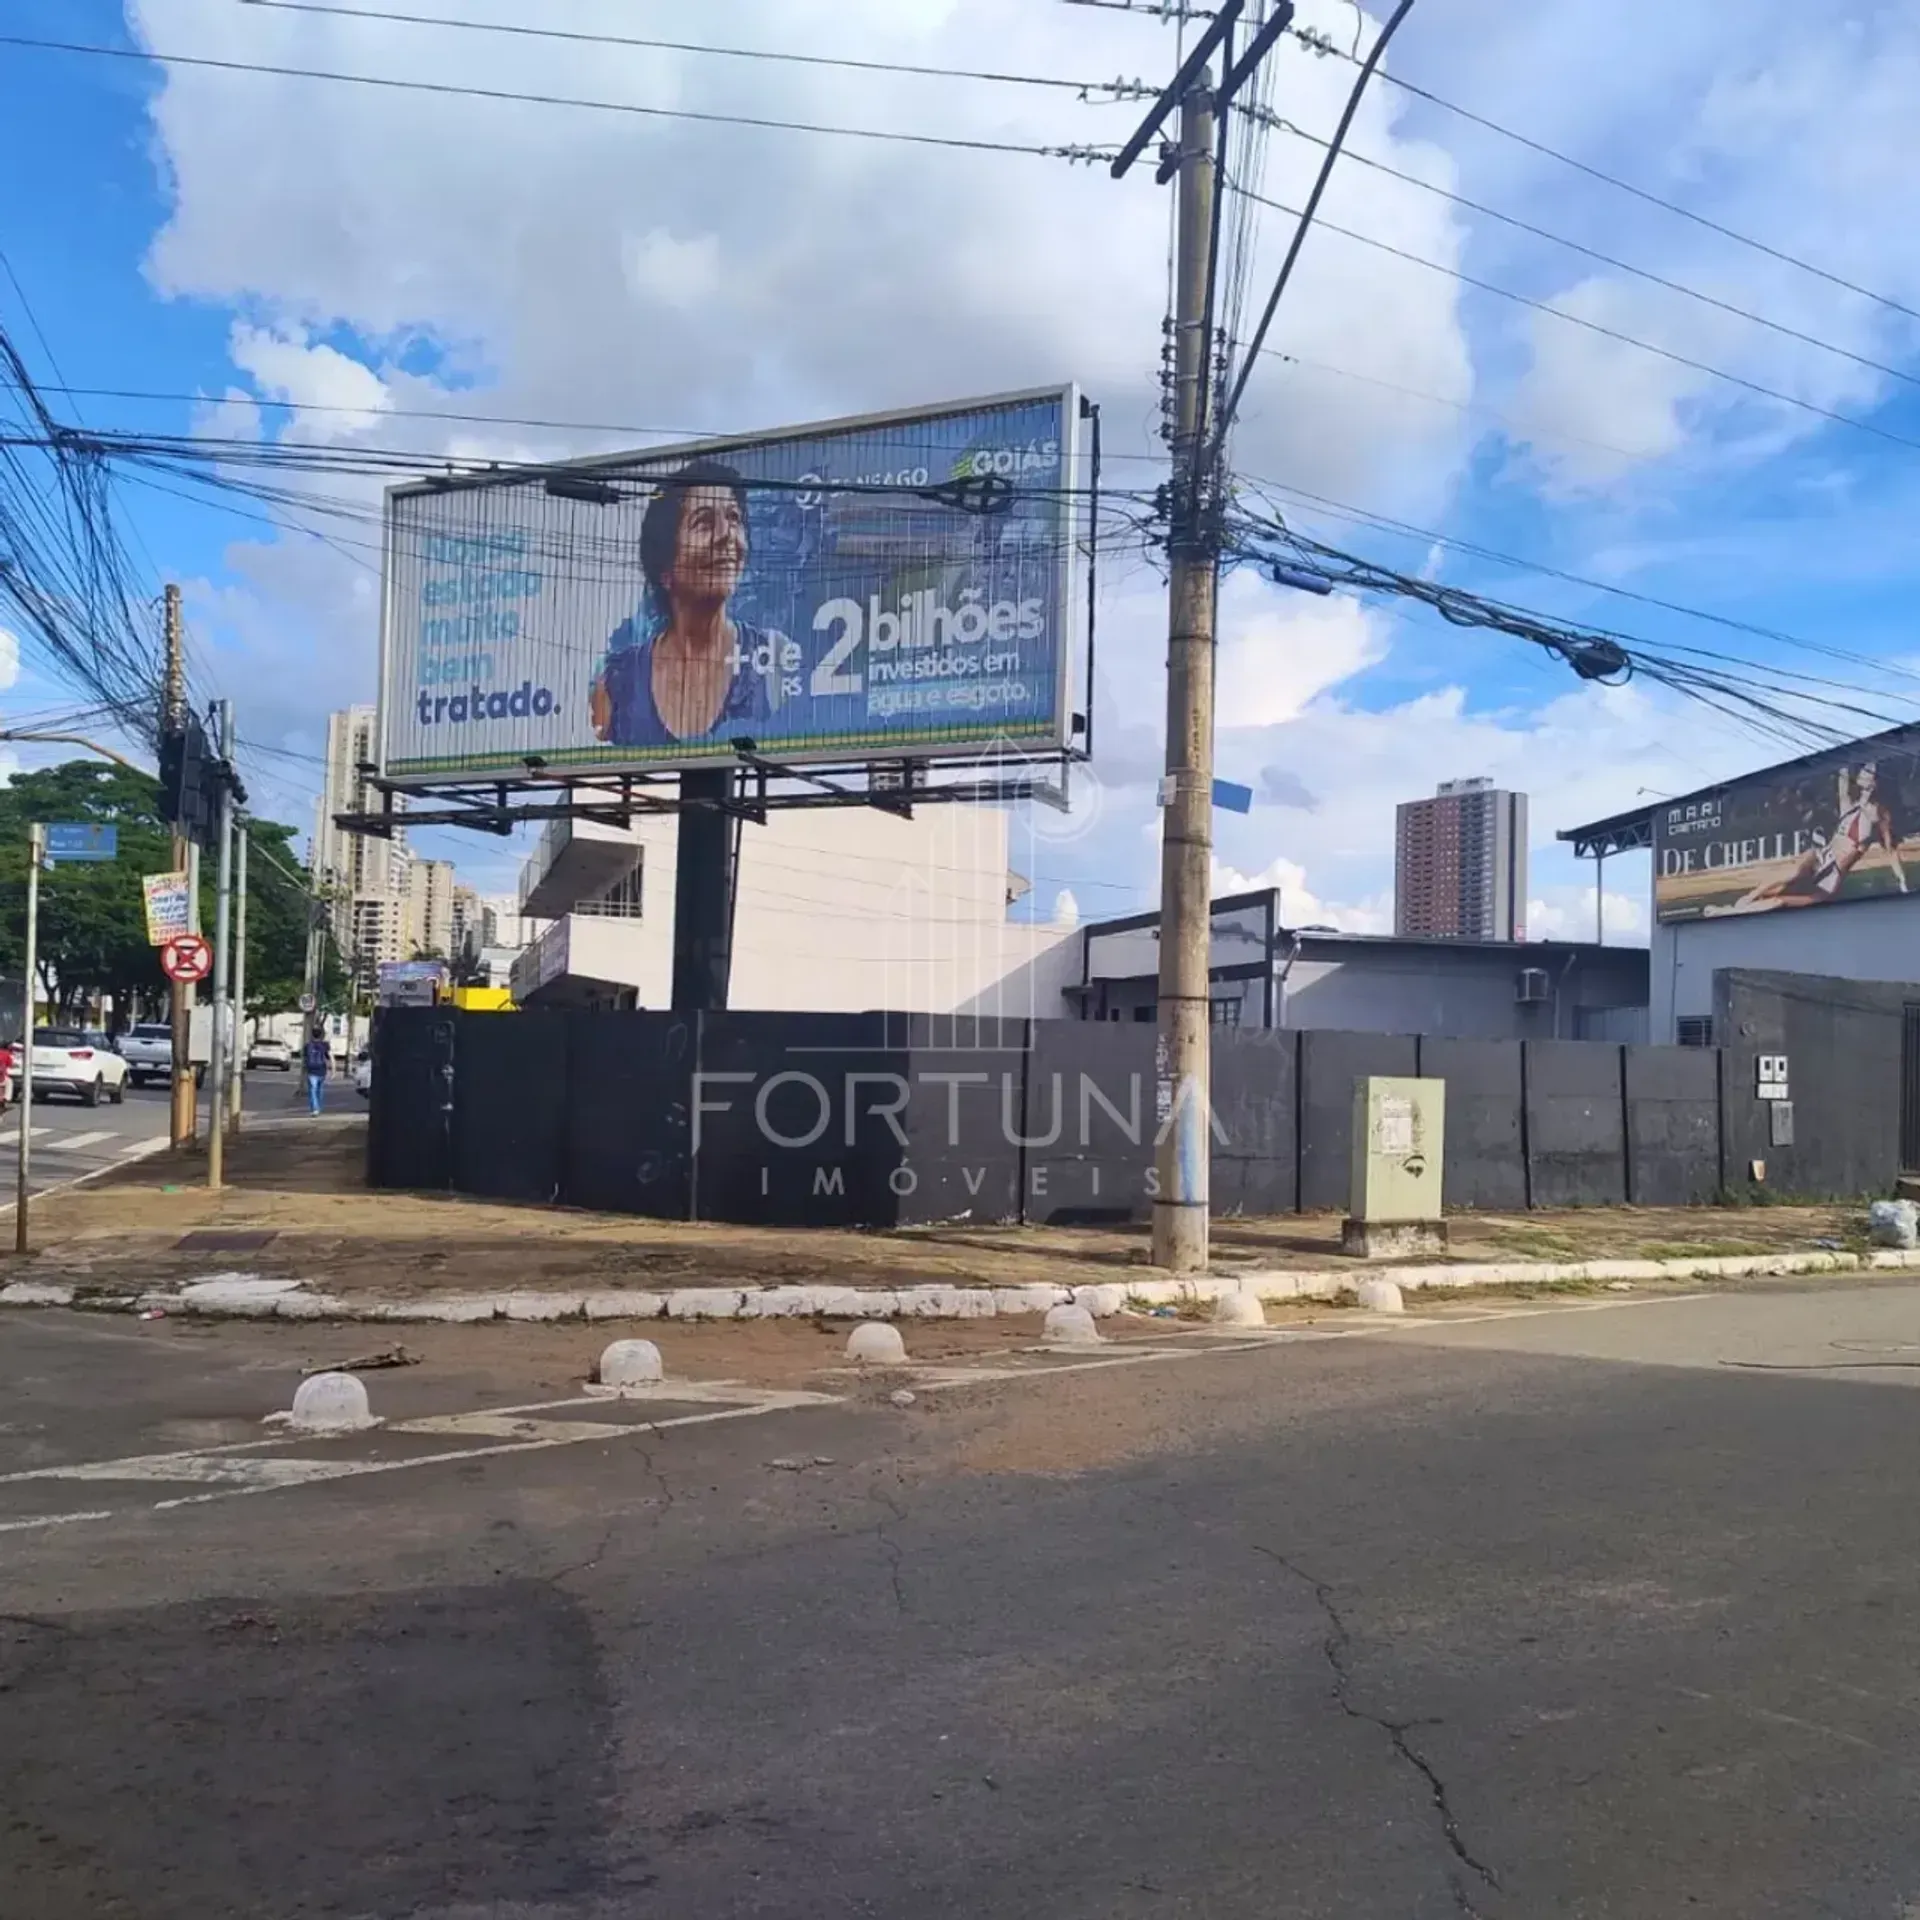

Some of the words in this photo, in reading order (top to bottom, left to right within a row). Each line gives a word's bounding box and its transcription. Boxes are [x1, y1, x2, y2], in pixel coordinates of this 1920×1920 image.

[971, 440, 1058, 477] GOIÁS
[424, 567, 542, 606] estado
[421, 603, 520, 646] muito
[810, 598, 863, 697] 2
[869, 588, 1045, 651] bilhões
[419, 651, 494, 686] bem
[869, 648, 978, 680] investidos
[984, 651, 1020, 673] em
[418, 681, 562, 726] tratado.
[1668, 799, 1721, 824] MARI
[1663, 847, 1698, 878] DE
[1704, 825, 1828, 871] CHELLES
